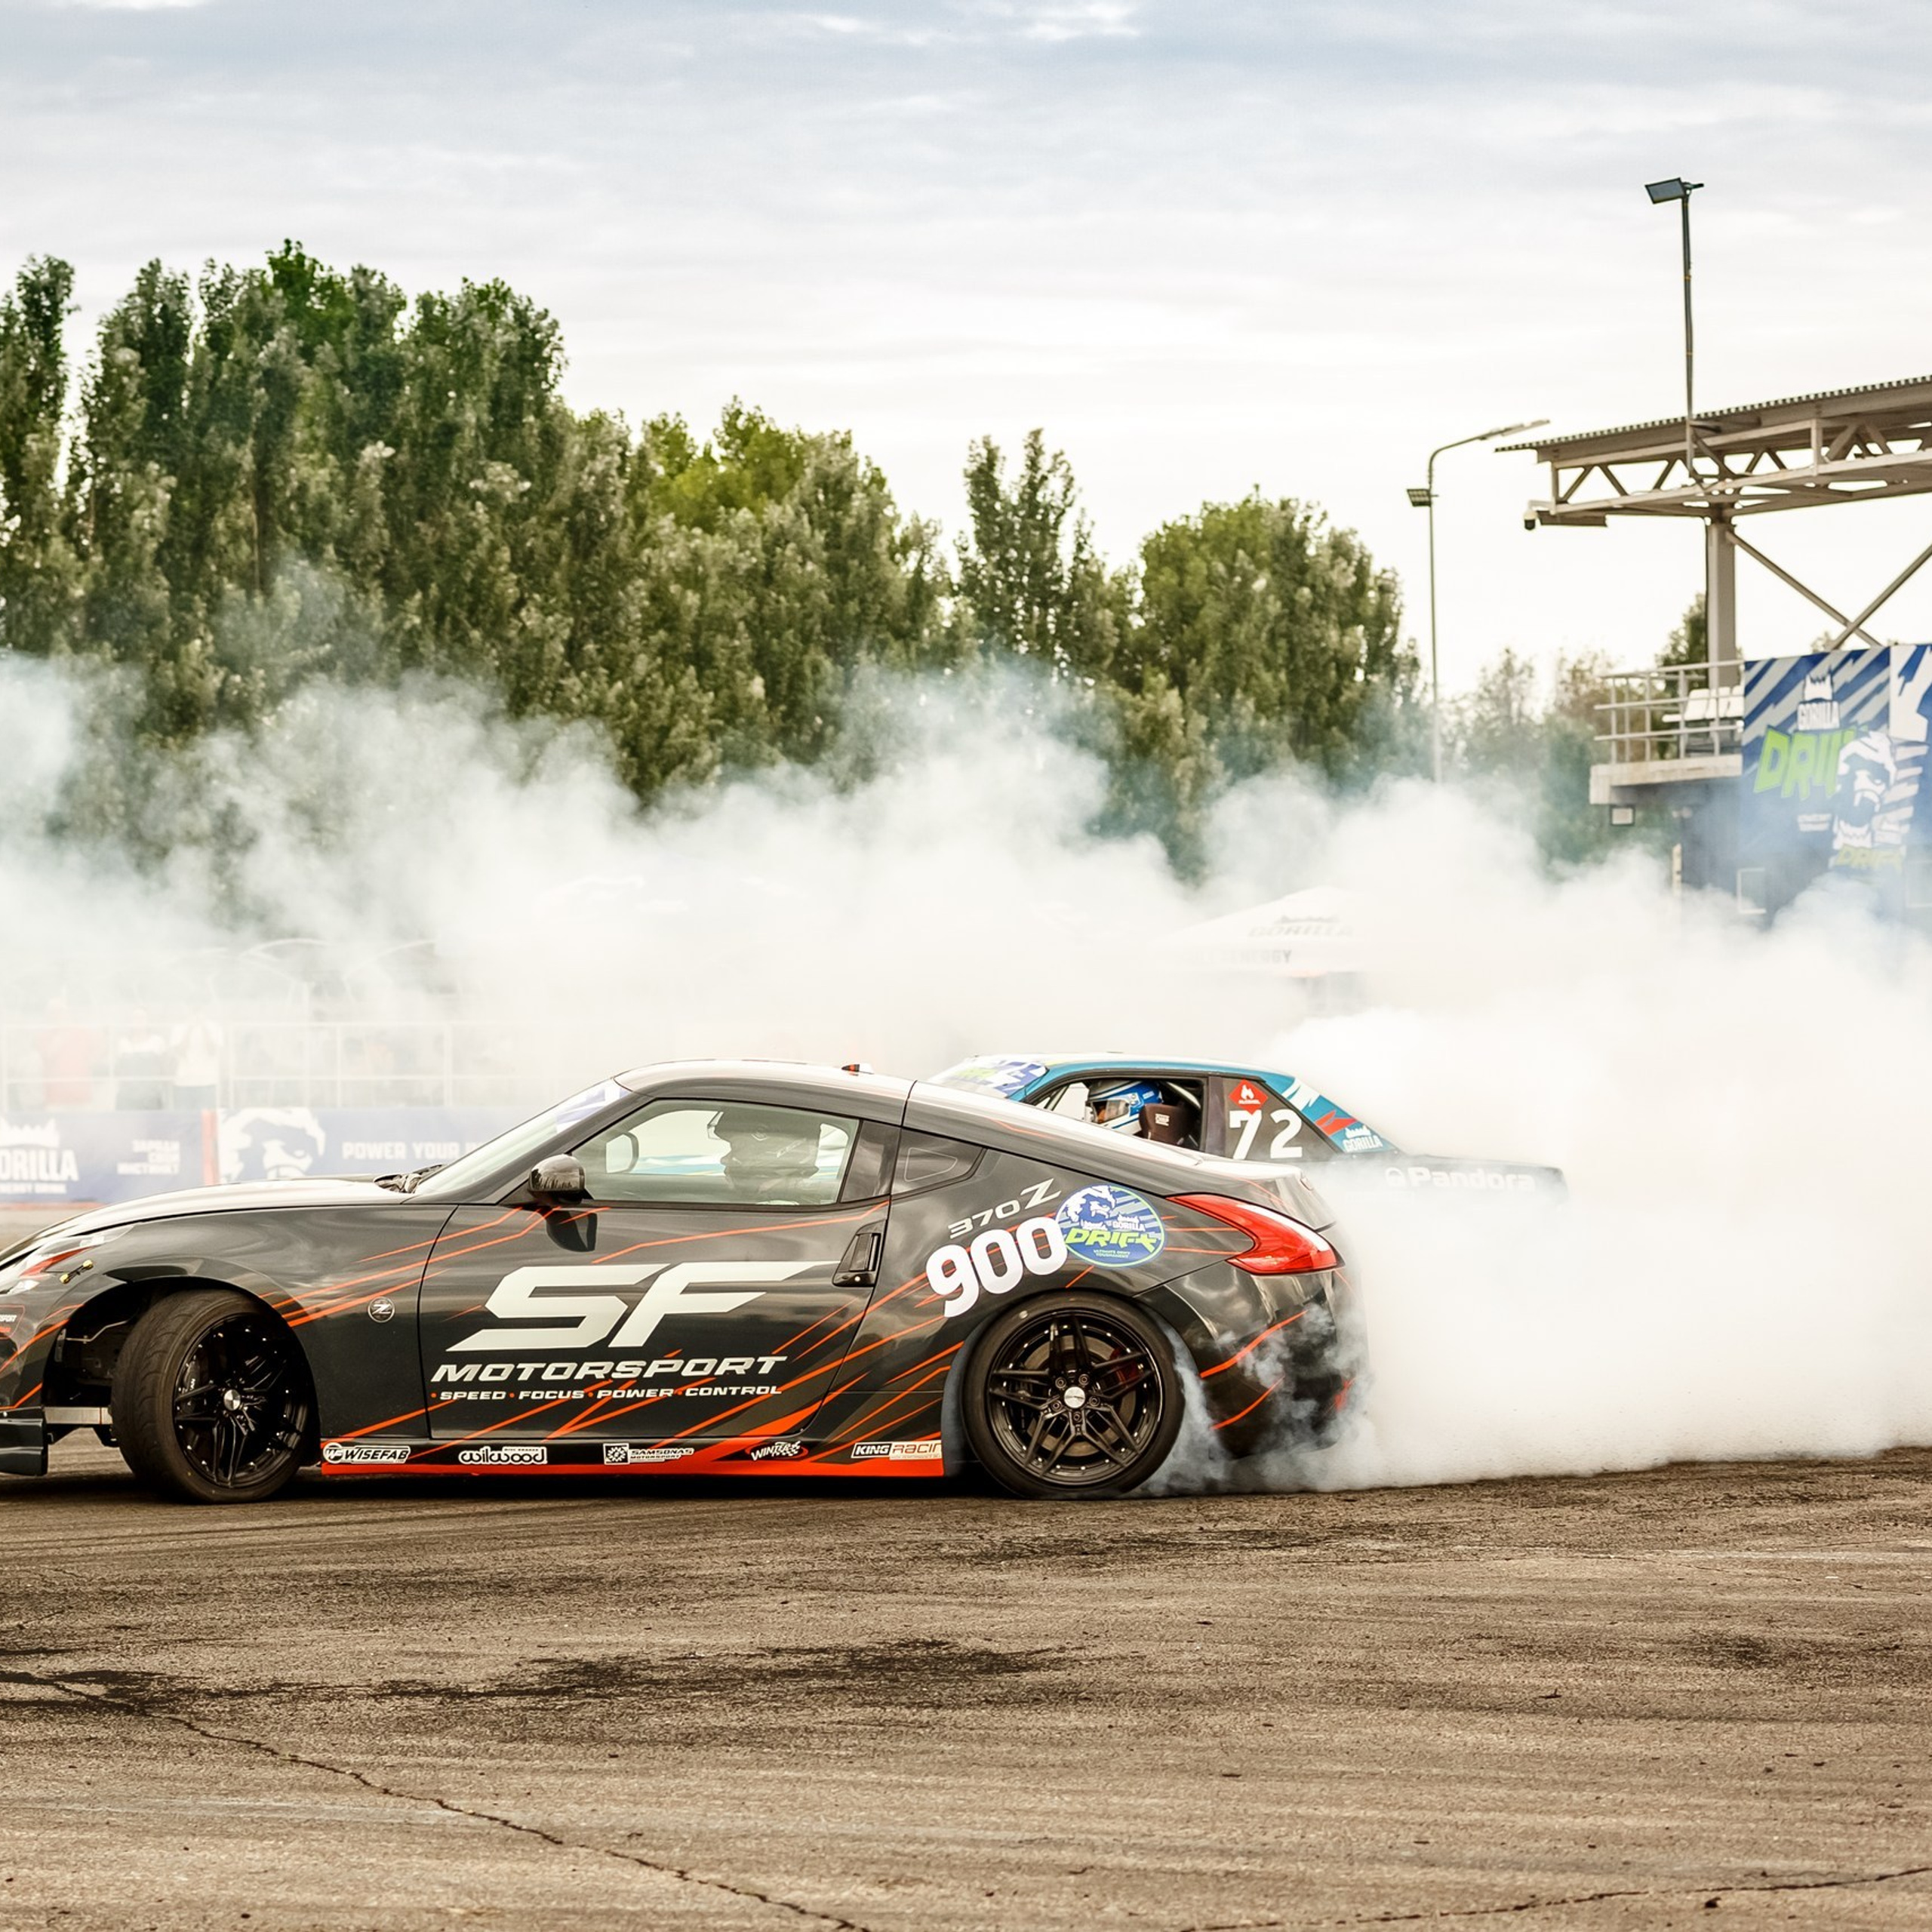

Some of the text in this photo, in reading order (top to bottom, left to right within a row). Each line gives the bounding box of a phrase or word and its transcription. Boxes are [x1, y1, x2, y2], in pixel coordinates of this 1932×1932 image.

[1229, 1109, 1303, 1159] 72
[1342, 1135, 1383, 1152] GORILLA
[342, 1141, 407, 1160] POWER
[411, 1141, 460, 1160] YOUR
[1407, 1166, 1537, 1192] Pandora
[948, 1178, 1062, 1239] 370Z
[1065, 1227, 1157, 1254] DRIFT
[926, 1217, 1069, 1318] 900
[445, 1260, 841, 1352] SF
[431, 1356, 787, 1383] MOTORSPORT
[439, 1386, 783, 1401] SPEED FOCUS POWER CONTROL
[344, 1447, 408, 1460] WISEFAB
[460, 1448, 545, 1463] wilwood
[855, 1444, 890, 1455] KING
